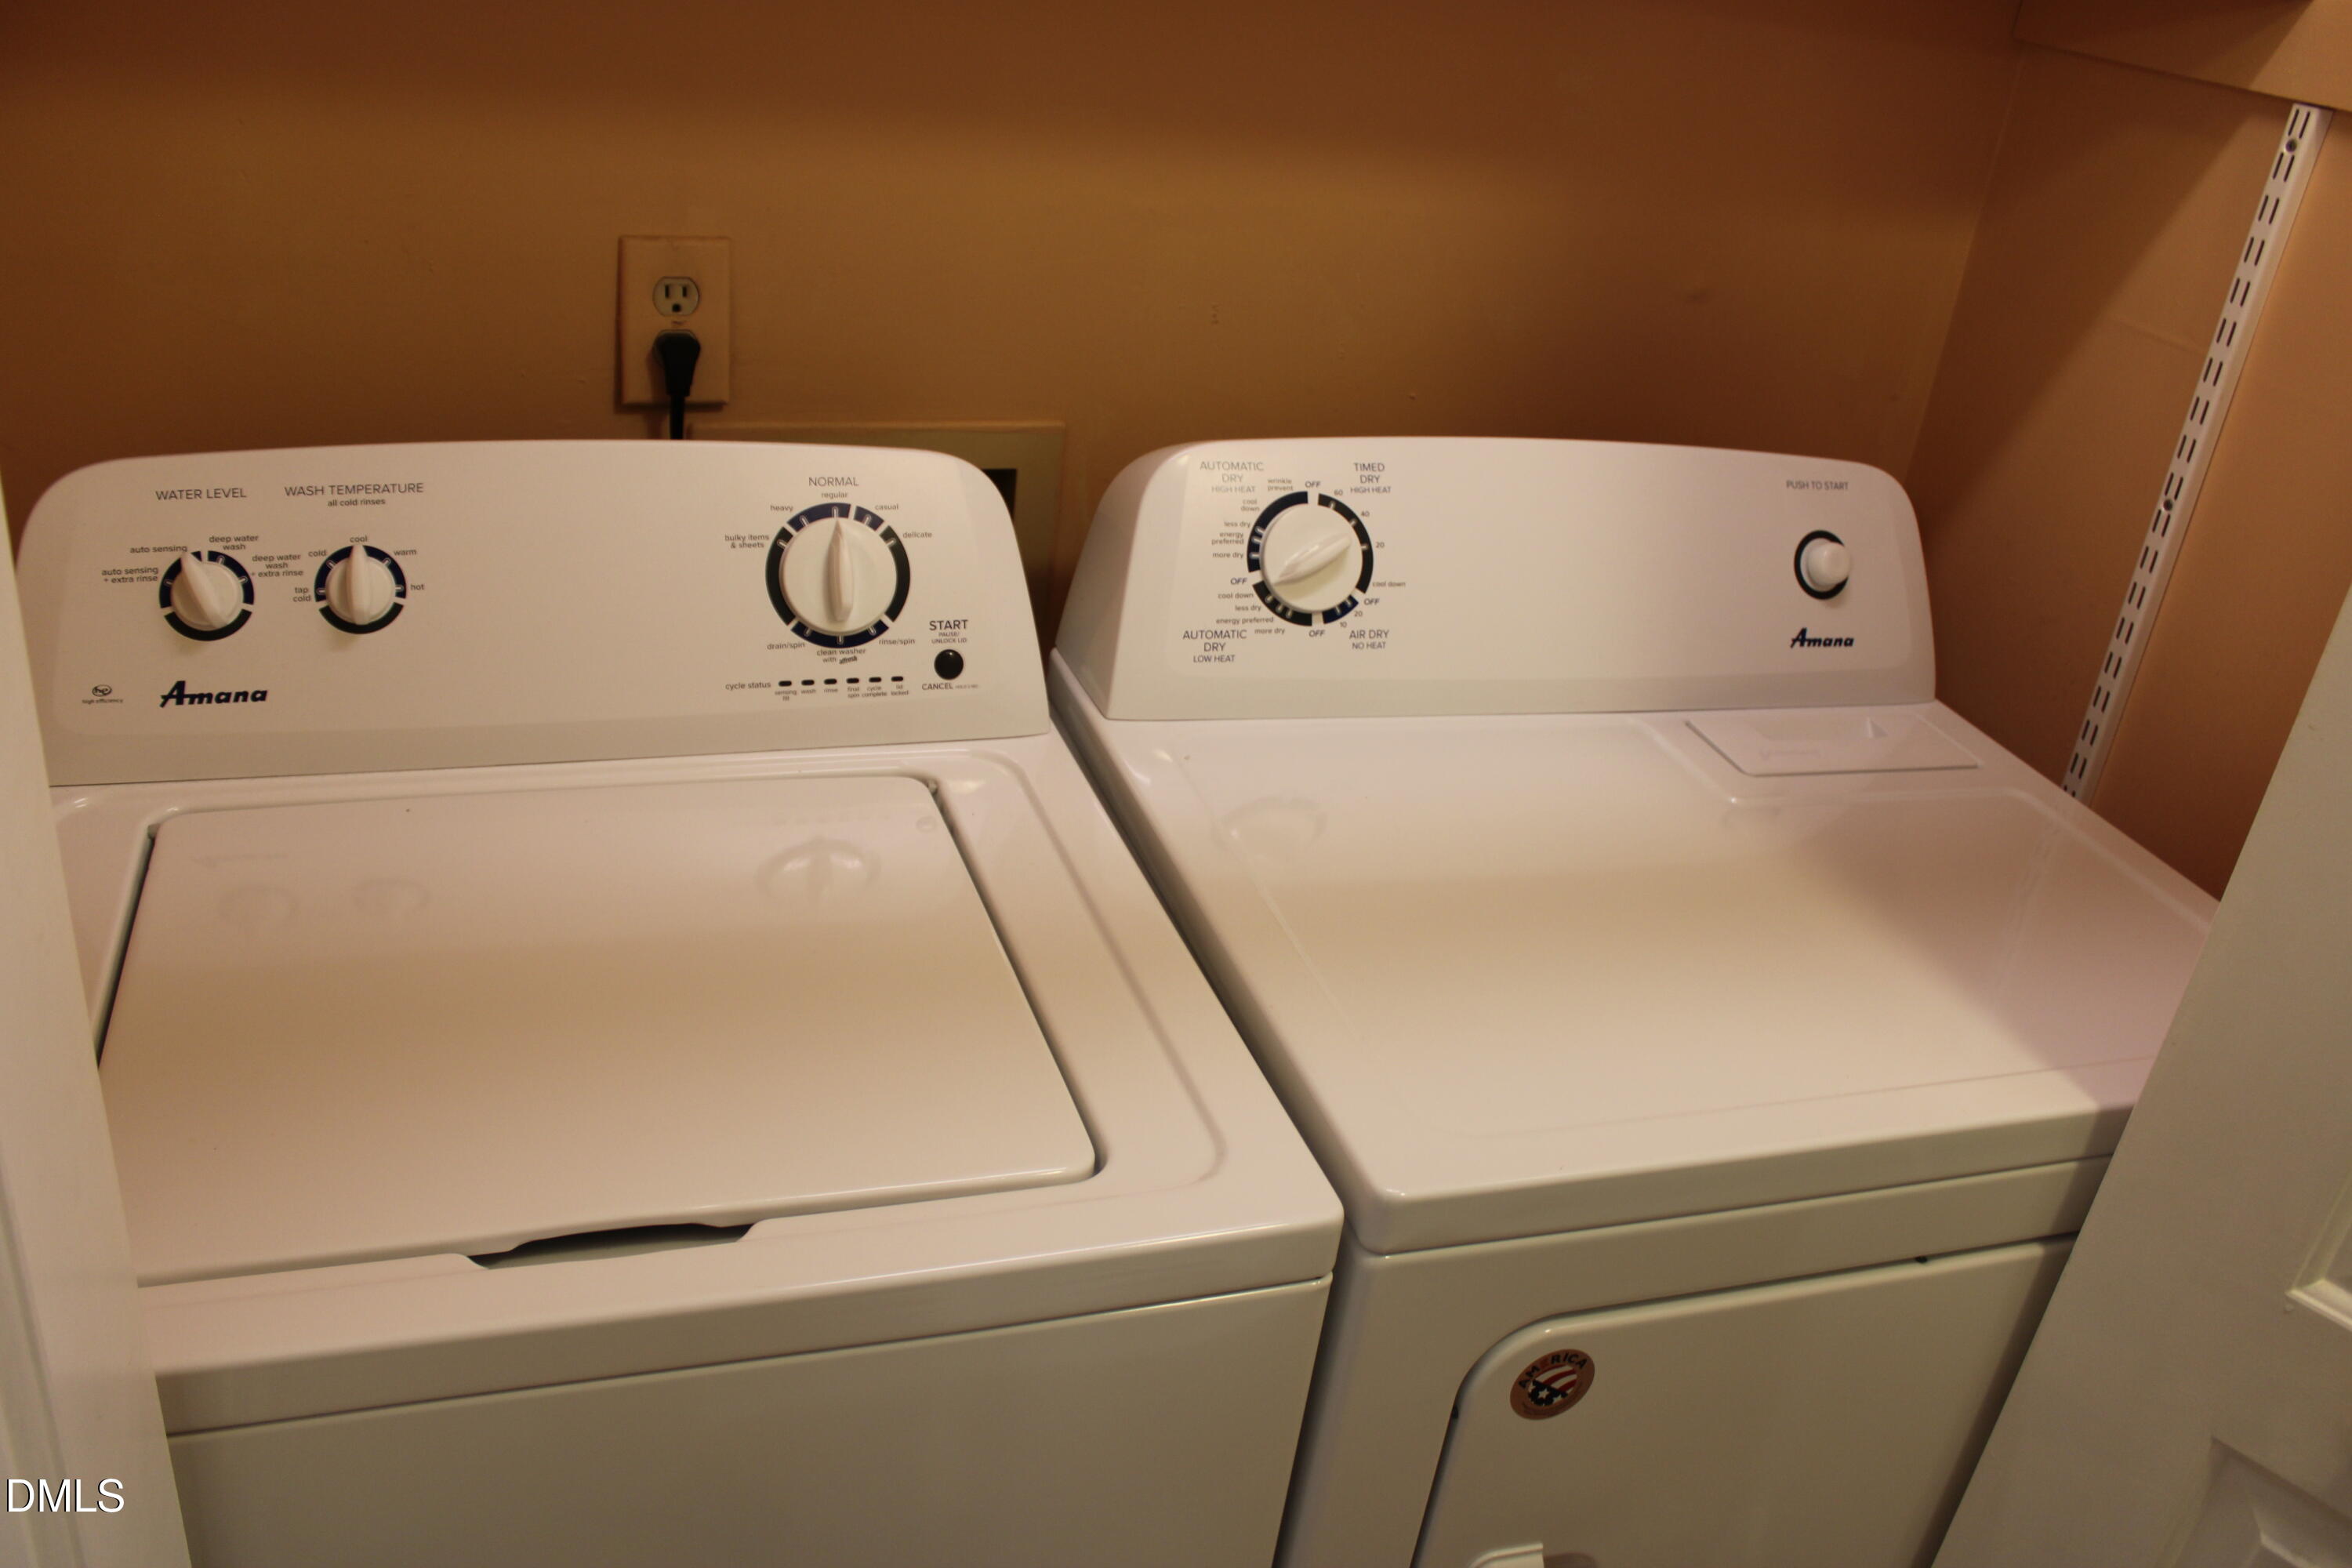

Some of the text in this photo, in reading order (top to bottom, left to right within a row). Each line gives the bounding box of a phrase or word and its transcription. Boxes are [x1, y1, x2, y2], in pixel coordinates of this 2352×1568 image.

[1200, 461, 1264, 470] AUTOMATIC
[1354, 463, 1385, 471] TIMED
[808, 477, 858, 487] NORMAL
[1221, 473, 1243, 482] DRY
[1359, 474, 1381, 484] DRY
[285, 483, 424, 496] WASH TEMPERATURE
[1786, 481, 1809, 489] PUSH
[1824, 481, 1849, 490] START
[155, 488, 246, 500] WATER LEVEL
[724, 534, 745, 543] bulky
[252, 554, 274, 563] deep
[125, 567, 158, 575] sensing
[295, 587, 308, 596] tap
[929, 619, 968, 630] START
[1183, 630, 1247, 640] AUTOMATIC
[1349, 630, 1389, 639] AIR DRY
[1791, 628, 1854, 648] Amana
[1203, 642, 1225, 652] DRY
[159, 680, 267, 708] Amana
